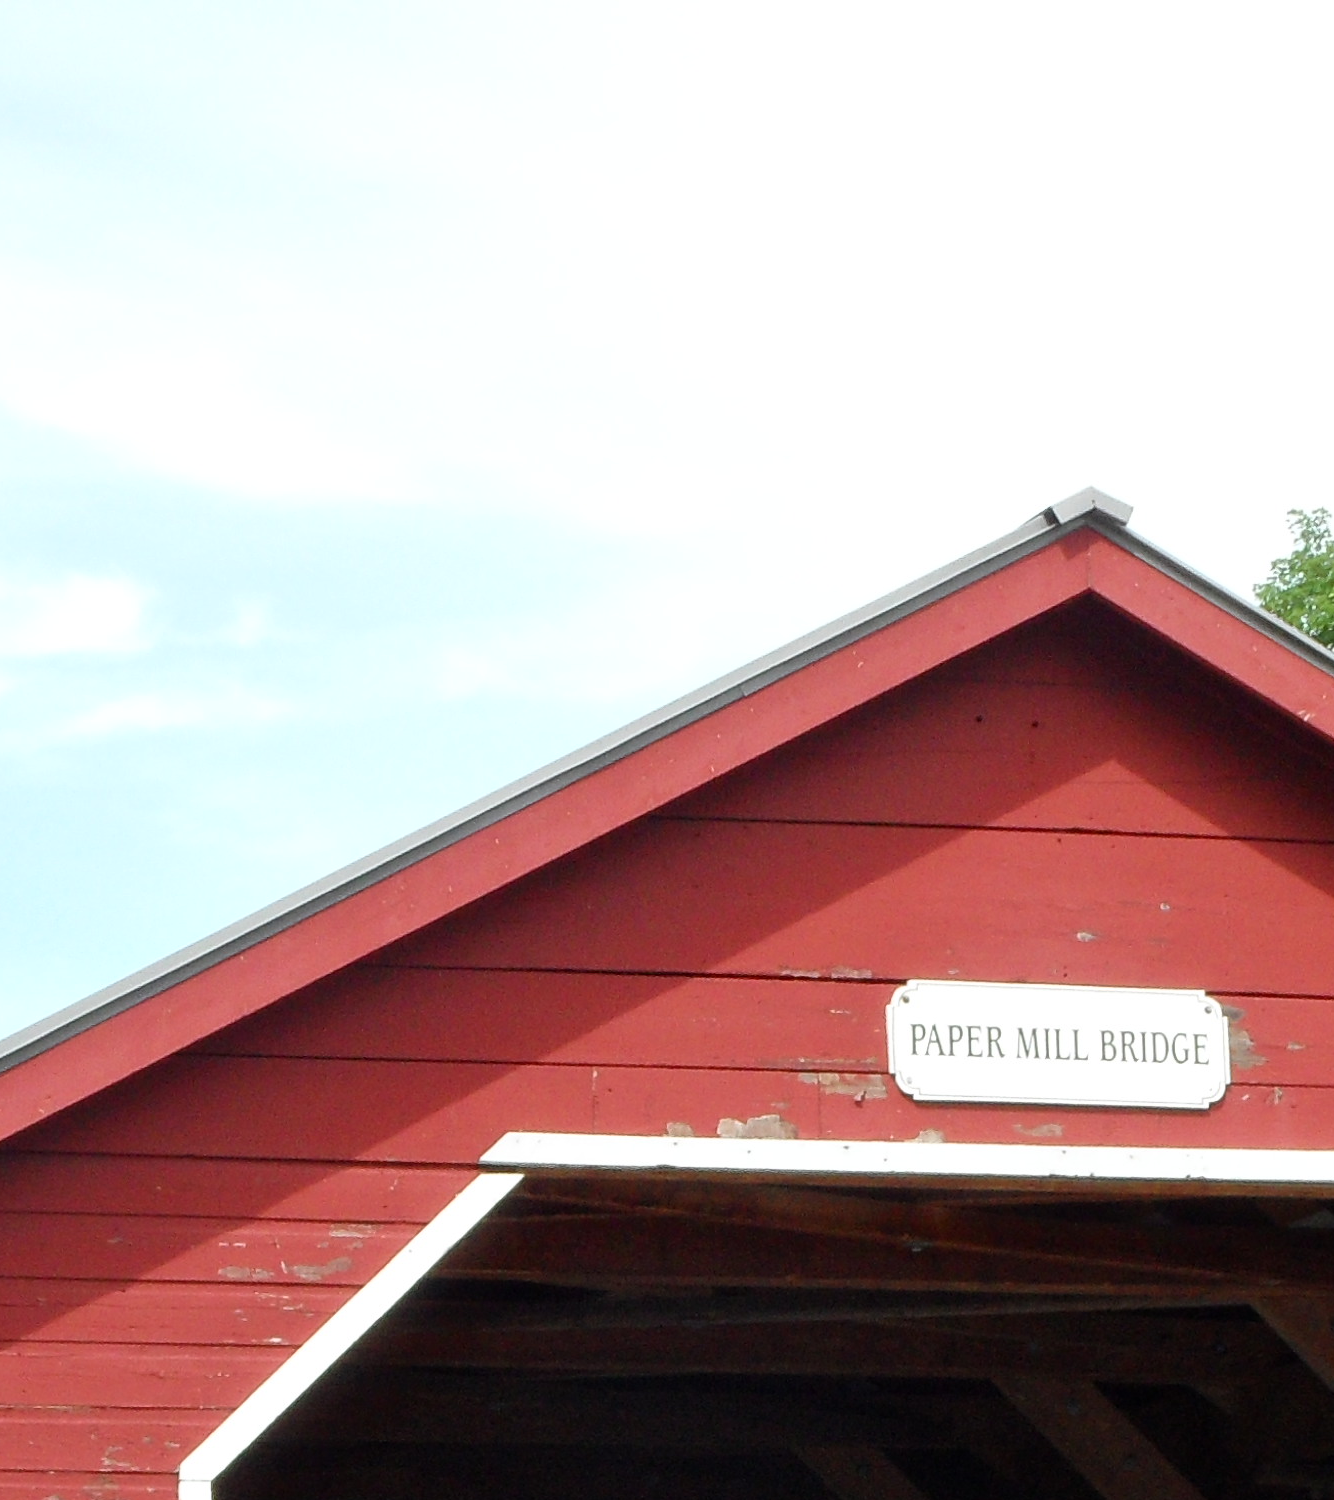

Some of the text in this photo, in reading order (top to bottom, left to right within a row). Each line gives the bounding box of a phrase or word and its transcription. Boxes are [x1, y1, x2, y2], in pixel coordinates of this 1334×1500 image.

[909, 1023, 1211, 1066] PAPER MILL BRIDGE
